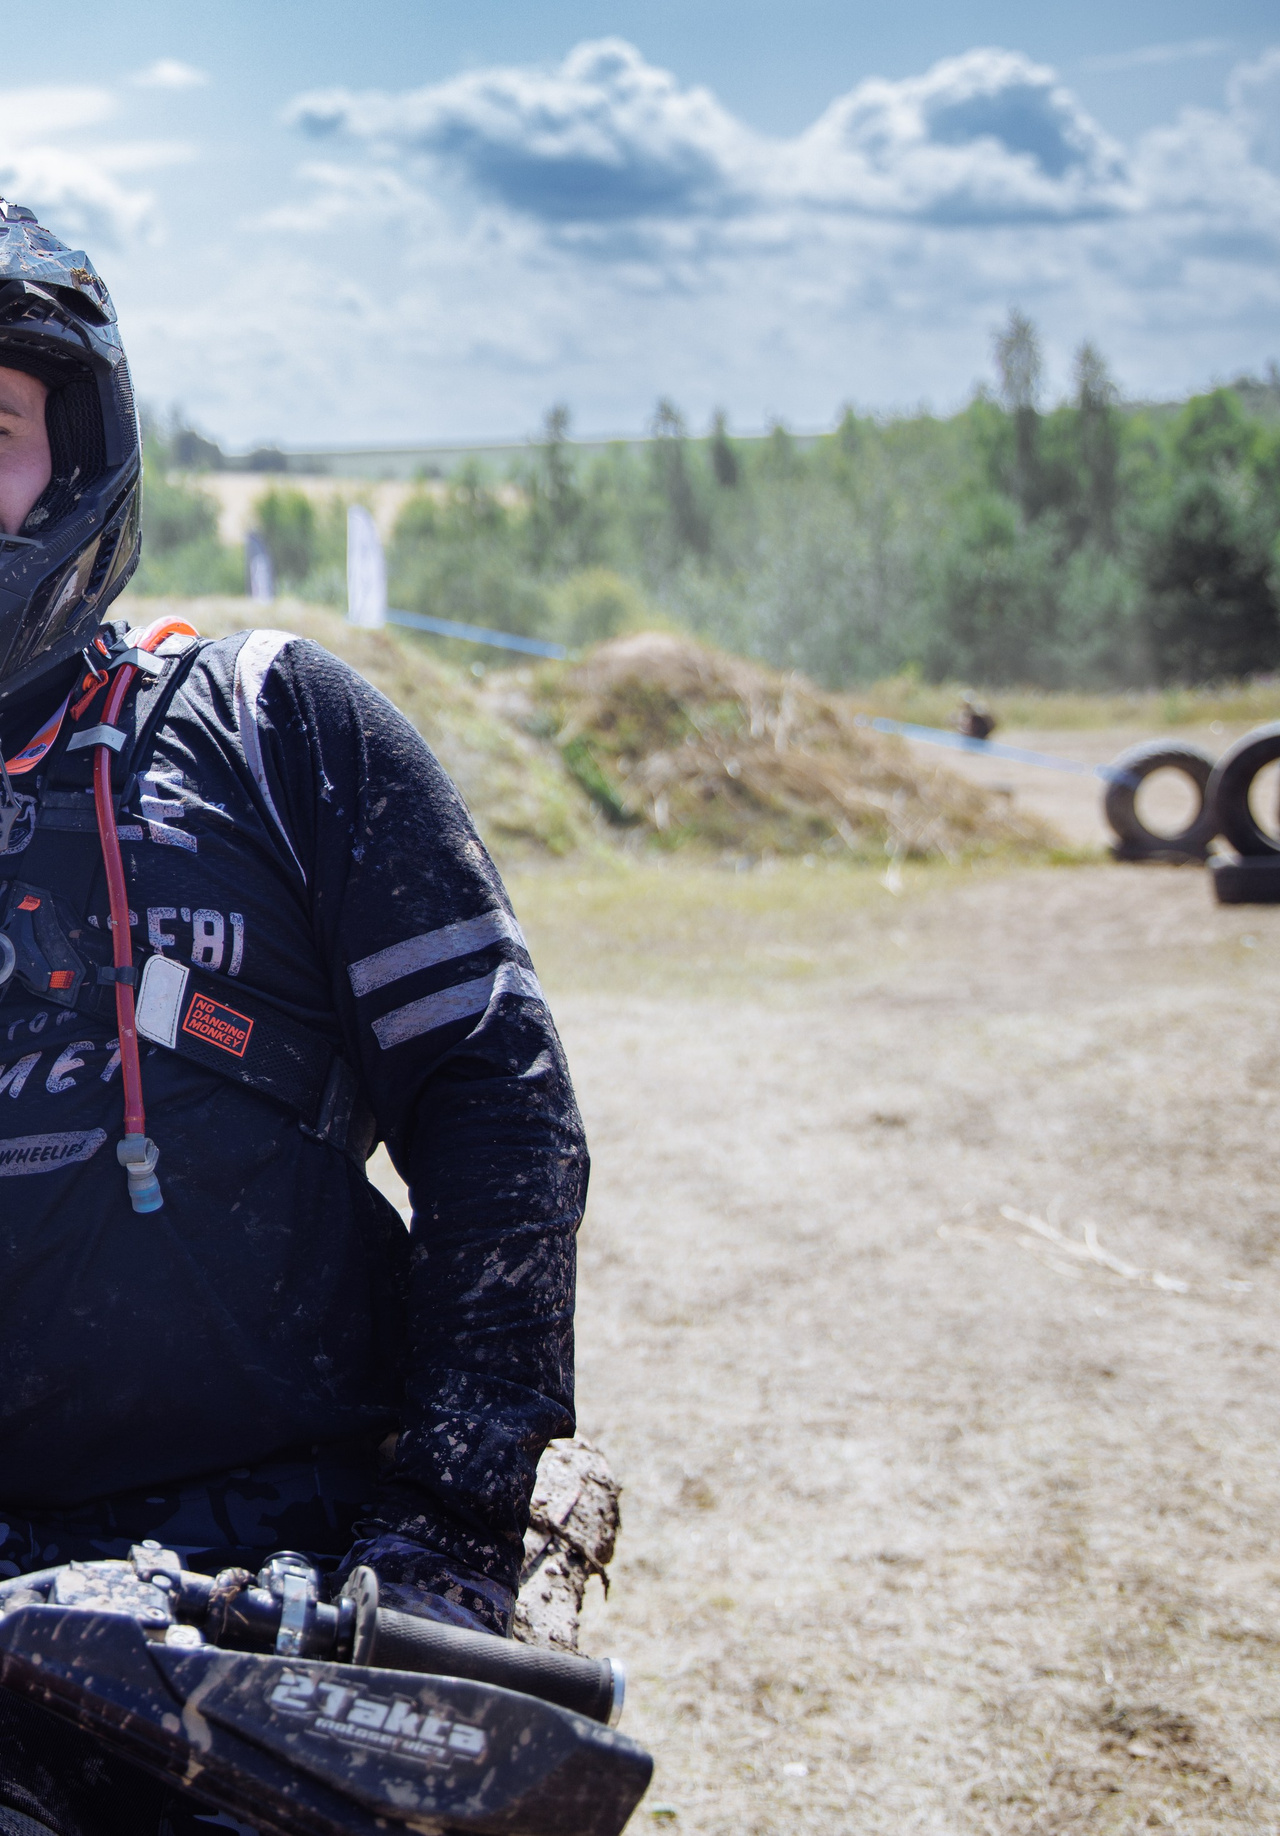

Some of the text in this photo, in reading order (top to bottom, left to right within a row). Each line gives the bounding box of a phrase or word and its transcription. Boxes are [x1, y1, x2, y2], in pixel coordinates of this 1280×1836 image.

[195, 996, 217, 1016] NO
[189, 1018, 244, 1050] MONKEY
[192, 1007, 247, 1043] DANCING
